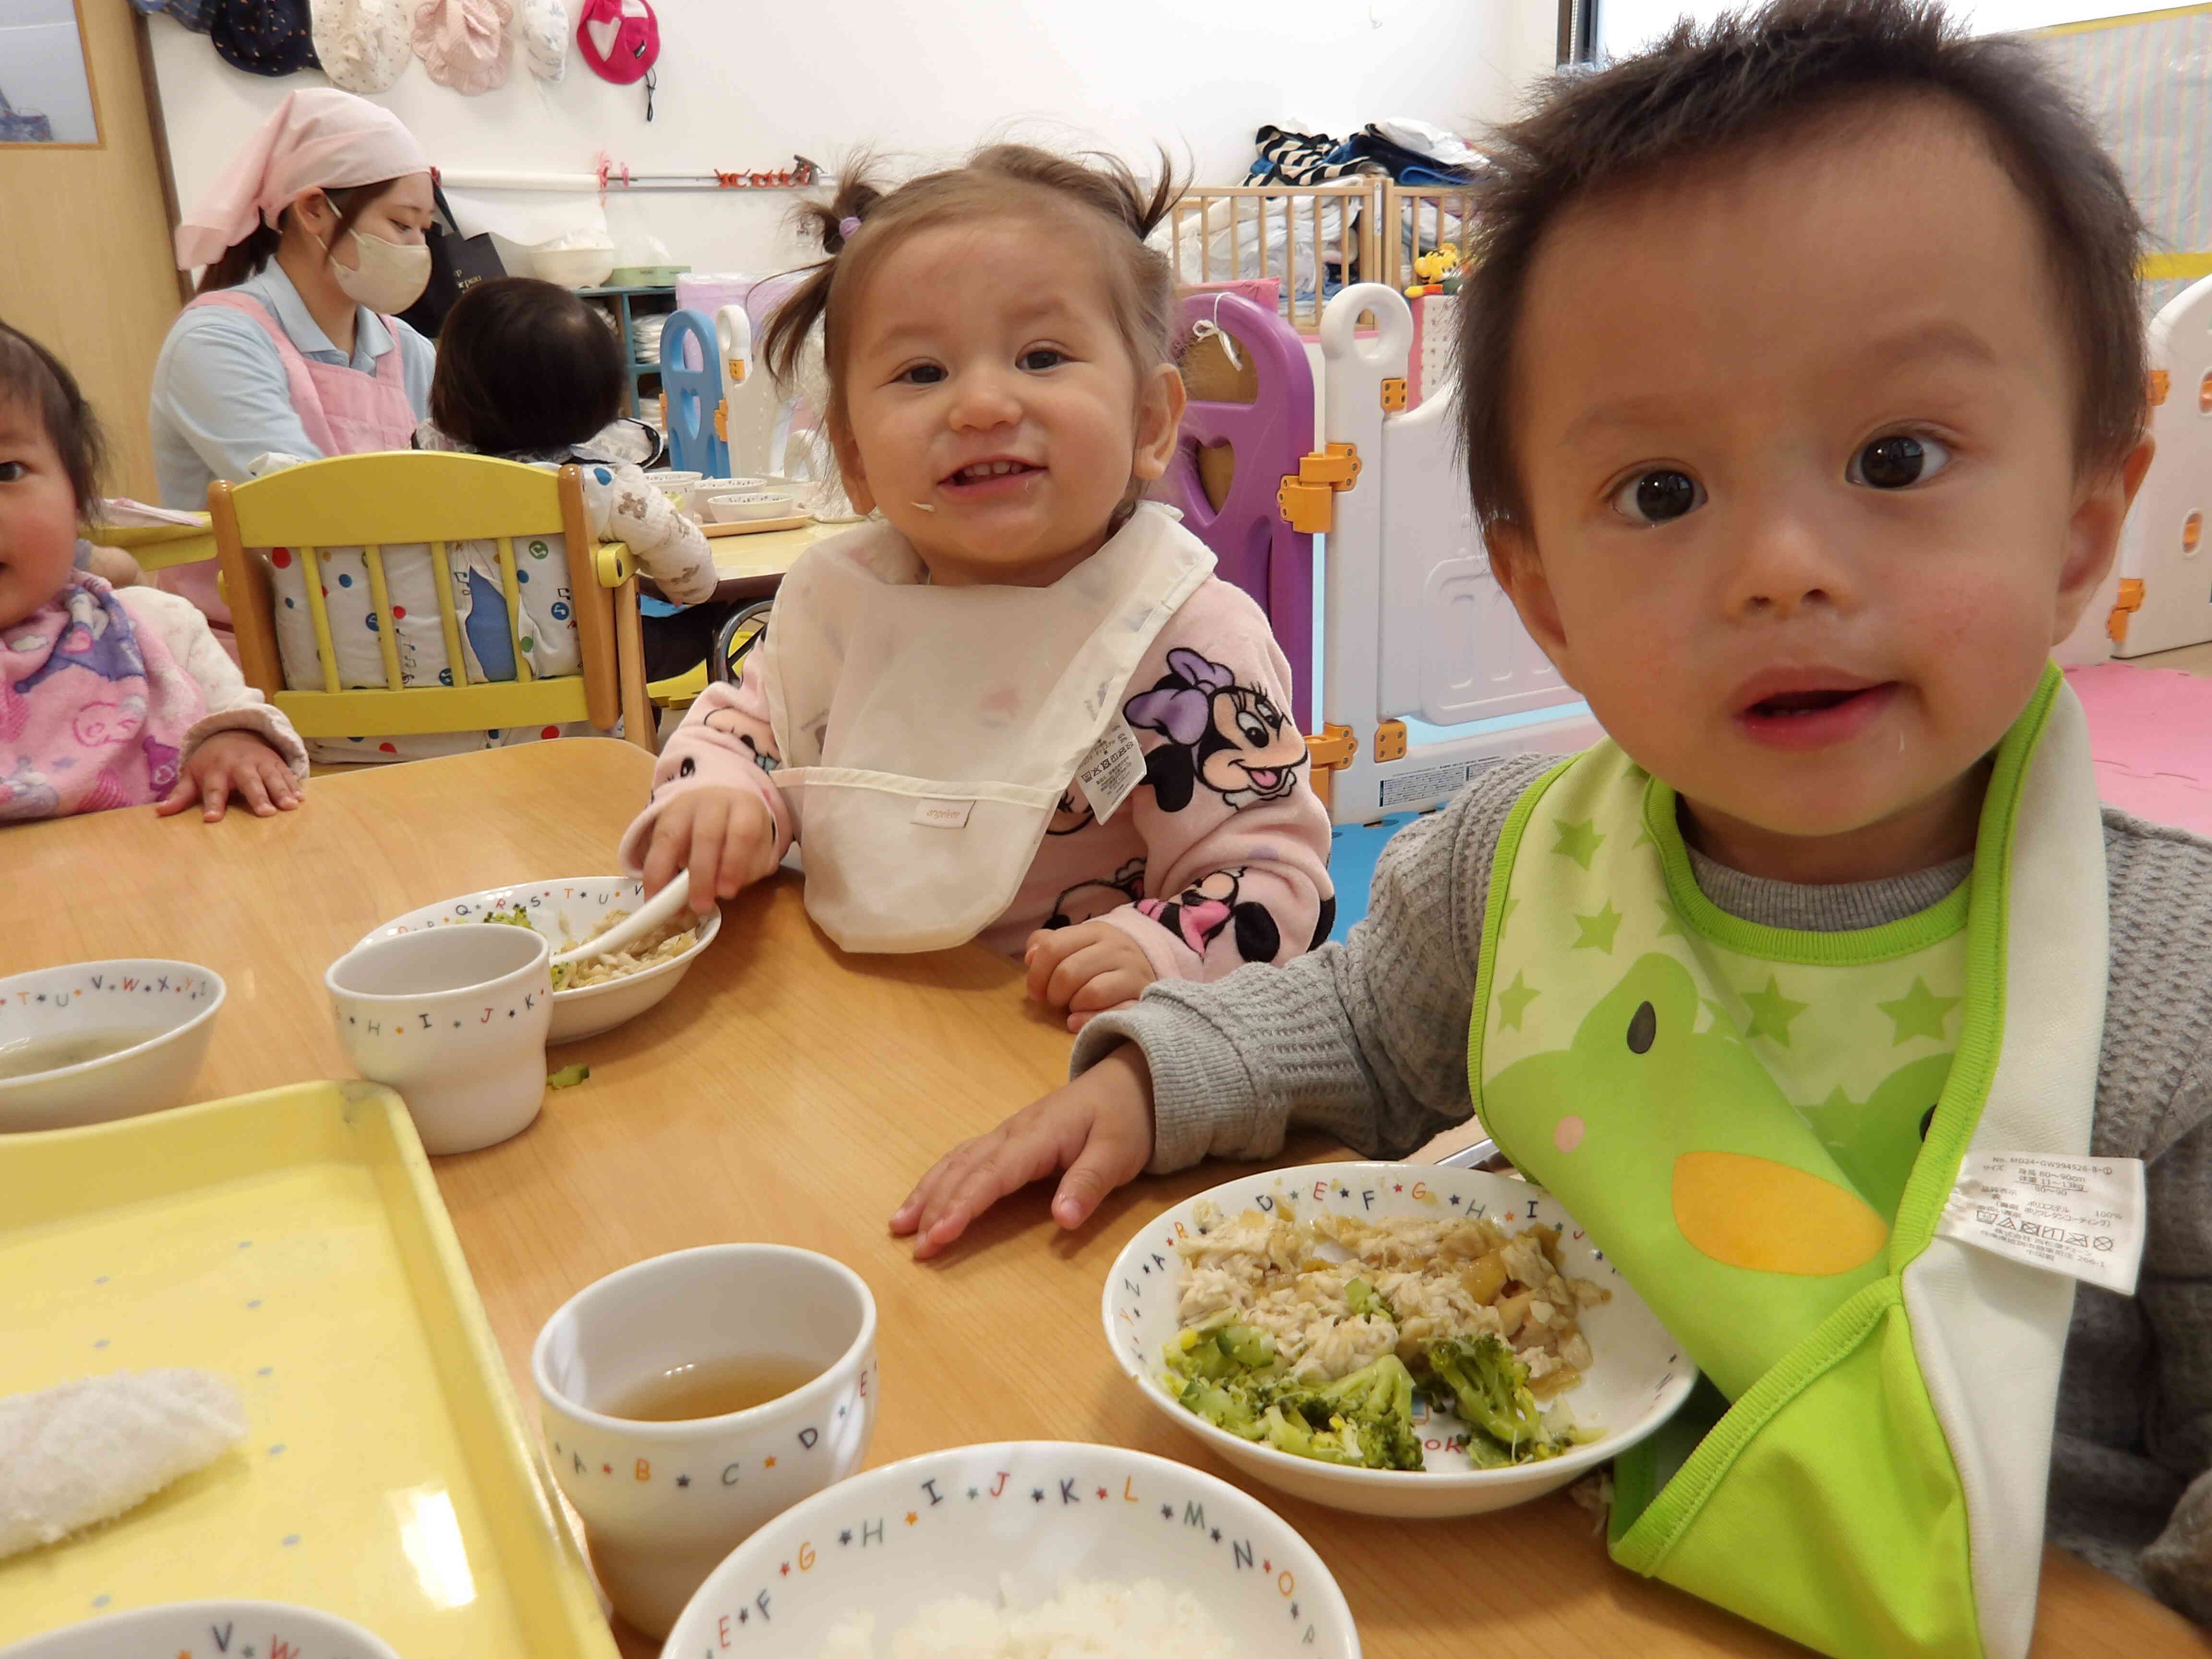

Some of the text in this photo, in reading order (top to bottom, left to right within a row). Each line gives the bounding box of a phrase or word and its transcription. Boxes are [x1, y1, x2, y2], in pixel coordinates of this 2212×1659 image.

[456, 904, 471, 915] Q
[496, 898, 506, 910] R
[530, 896, 541, 907] S
[564, 889, 574, 899] T
[599, 893, 609, 904] U
[17, 991, 30, 1005] T
[56, 994, 69, 1007] U
[91, 975, 103, 989] V
[122, 976, 140, 992] W
[157, 976, 169, 992] X
[368, 1020, 380, 1036] H
[419, 1013, 432, 1029] I
[481, 1008, 493, 1023] J
[525, 994, 534, 1010] K
[1151, 1253, 1166, 1272] A
[1256, 1194, 1274, 1211] D
[1313, 1181, 1328, 1201] E
[1362, 1190, 1375, 1210] F
[1411, 1181, 1427, 1200] G
[1466, 1199, 1486, 1218] H
[1527, 1201, 1539, 1218] I
[635, 1459, 651, 1481] B
[722, 1463, 739, 1486] C
[797, 1428, 817, 1449] D
[719, 1614, 731, 1649] E
[798, 1541, 816, 1572] G
[863, 1518, 884, 1547] H
[922, 1479, 944, 1506] I
[989, 1471, 1010, 1498] J
[1060, 1478, 1080, 1504] K
[1124, 1475, 1139, 1502] L
[1184, 1500, 1205, 1529] M
[1233, 1539, 1253, 1569] N
[212, 1622, 233, 1652] V
